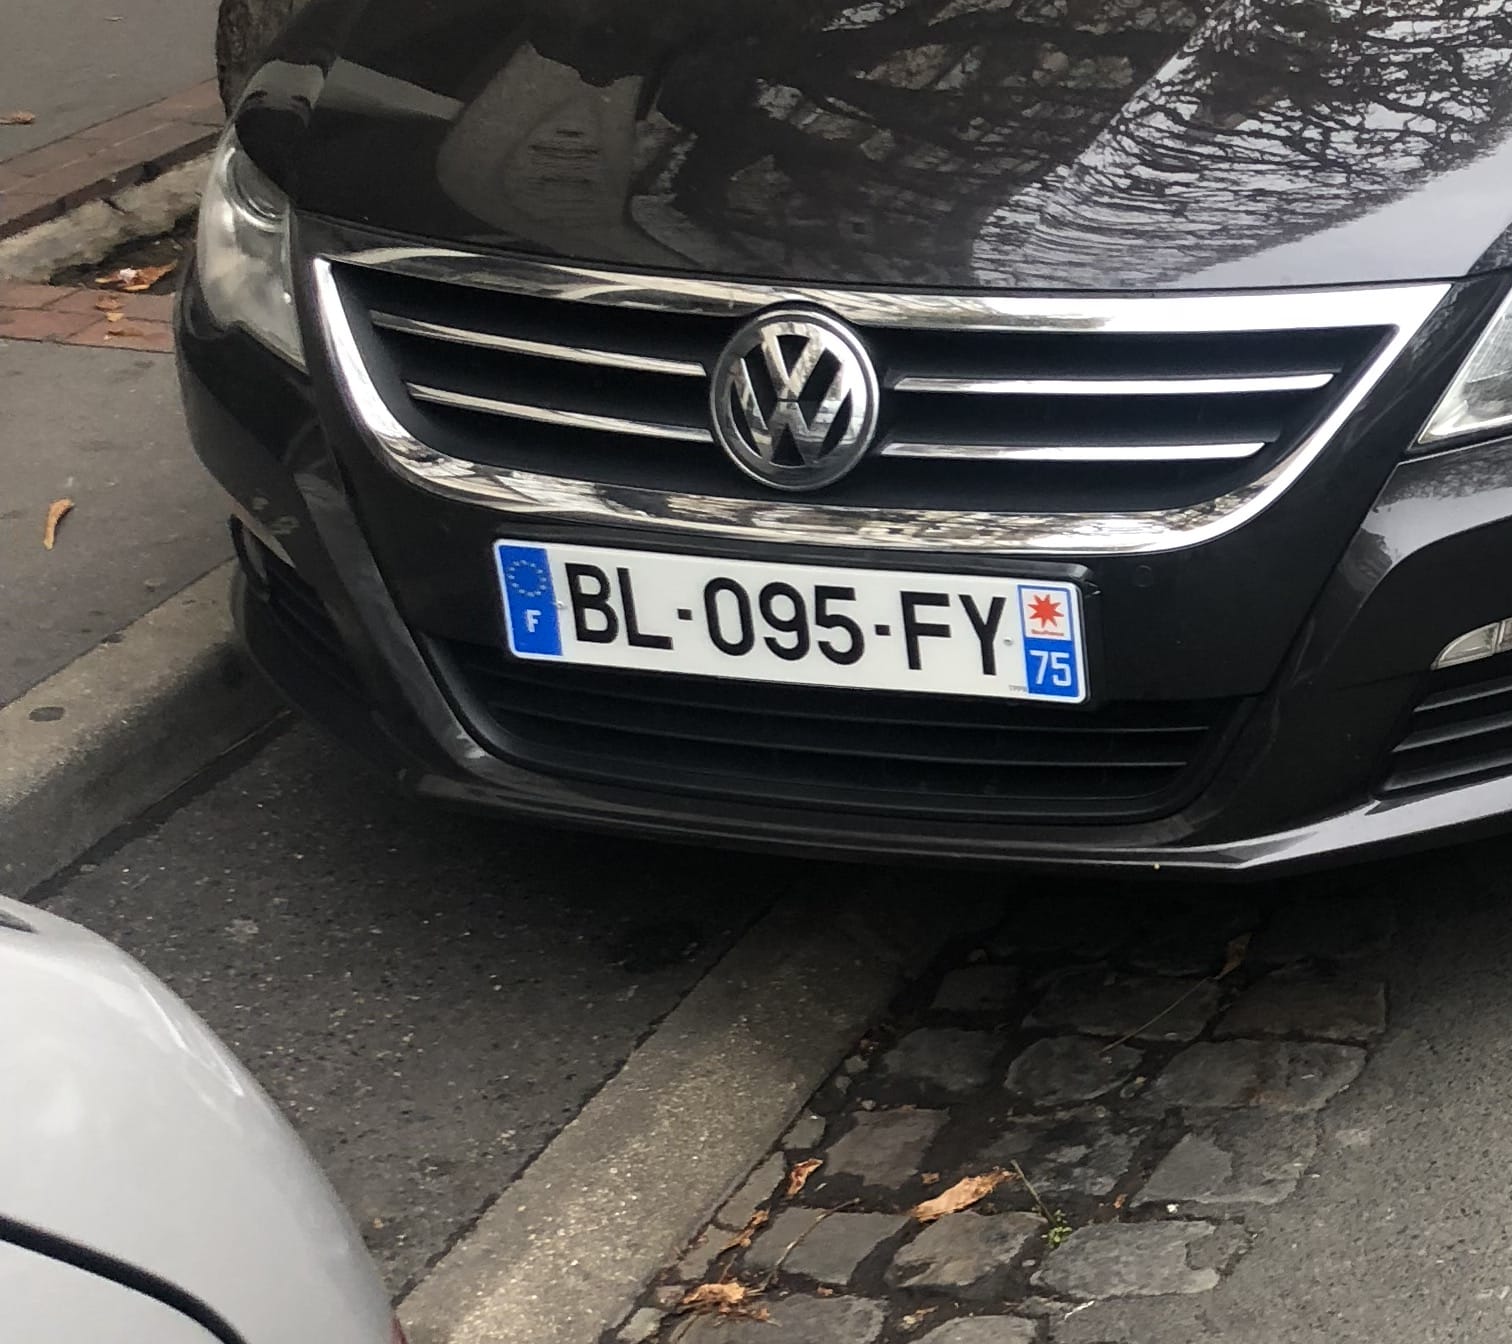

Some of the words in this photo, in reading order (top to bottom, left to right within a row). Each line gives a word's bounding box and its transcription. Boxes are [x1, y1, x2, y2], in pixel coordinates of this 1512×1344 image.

[525, 609, 541, 633] F
[564, 562, 1006, 676] BL-095-FY
[1028, 649, 1072, 687] 75
